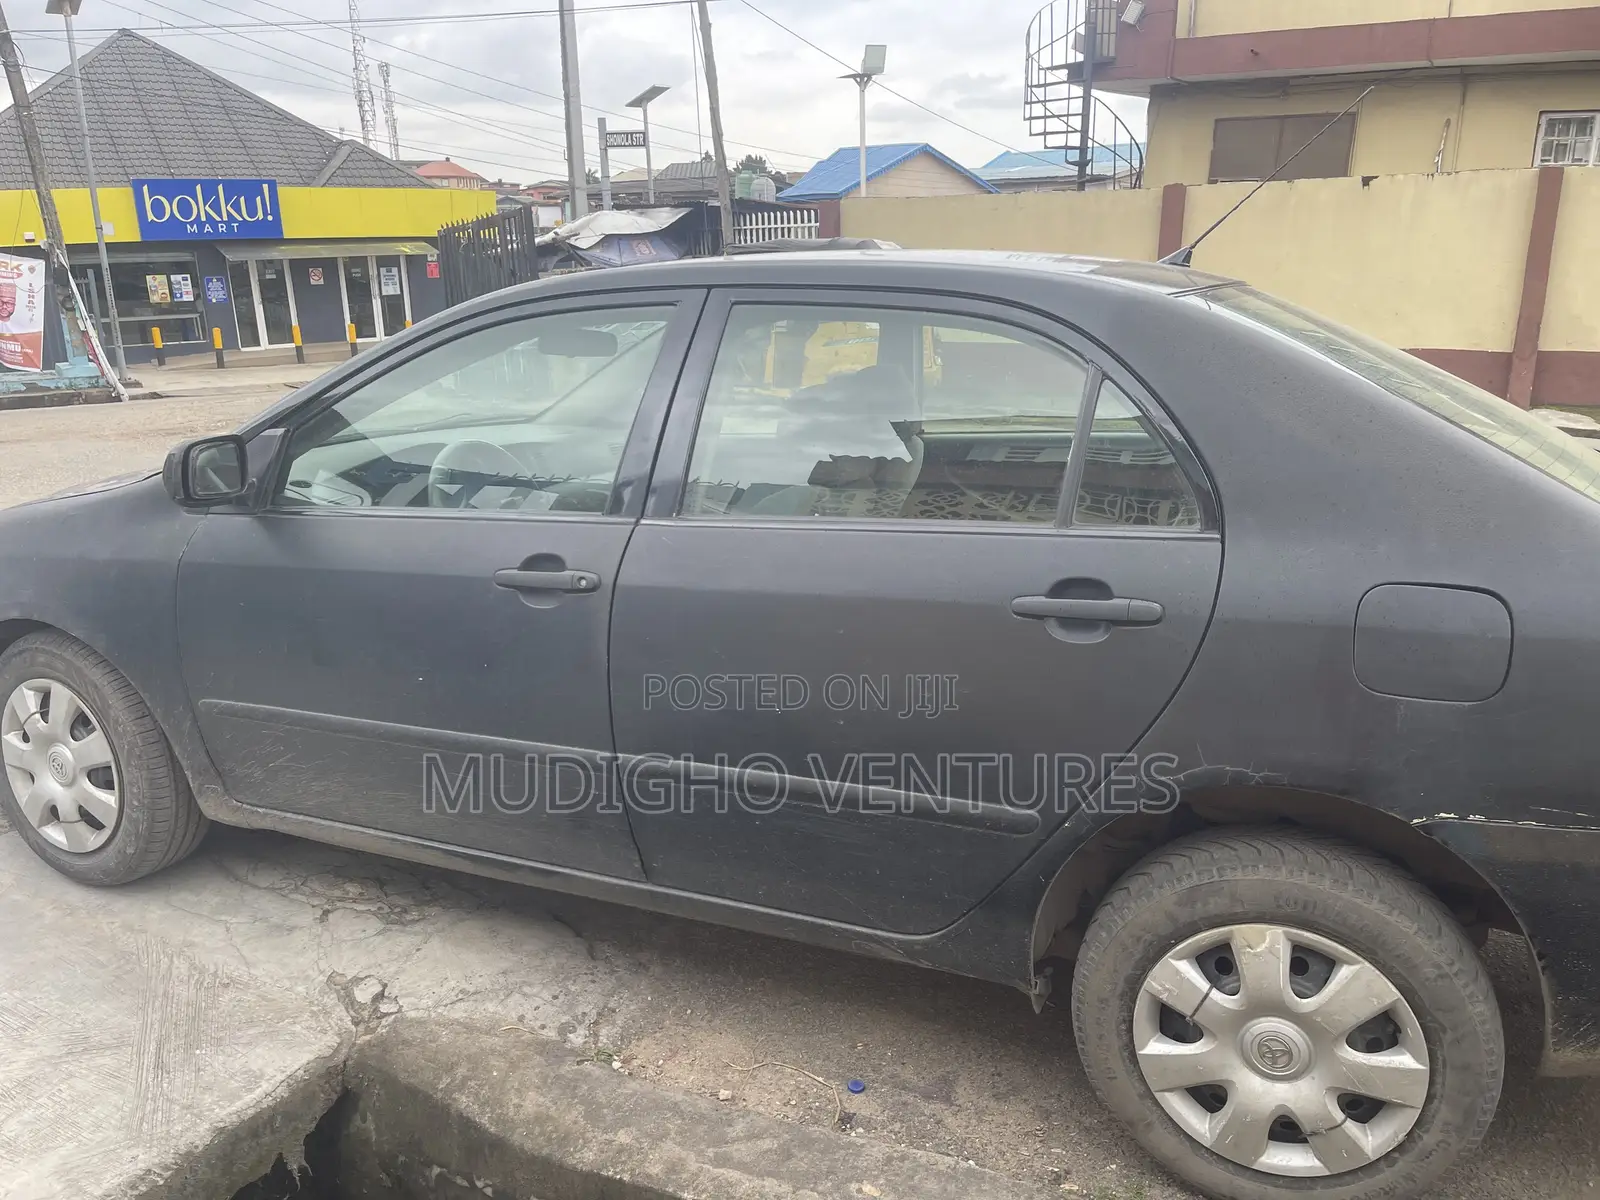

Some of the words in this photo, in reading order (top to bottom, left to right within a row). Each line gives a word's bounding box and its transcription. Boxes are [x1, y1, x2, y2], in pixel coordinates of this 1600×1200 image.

[606, 133, 632, 146] SHONOLA
[632, 133, 644, 146] STR
[142, 183, 273, 223] bokku!
[186, 223, 240, 234] MART
